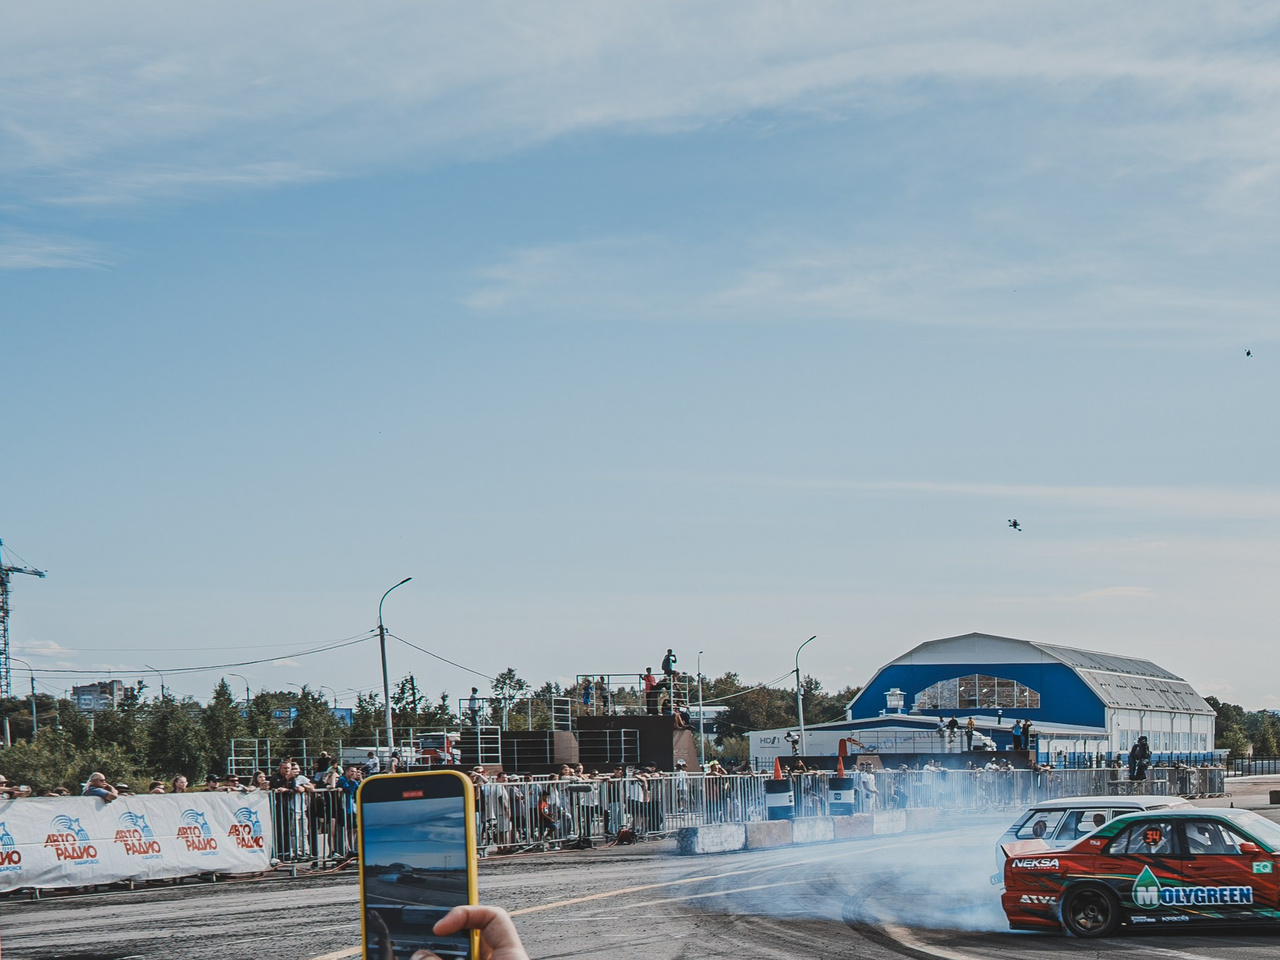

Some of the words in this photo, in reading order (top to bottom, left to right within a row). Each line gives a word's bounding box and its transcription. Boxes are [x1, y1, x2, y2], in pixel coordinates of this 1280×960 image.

[114, 829, 142, 843] АВТО
[176, 826, 201, 839] АВТО
[228, 824, 251, 837] АВТО
[1145, 831, 1160, 843] 34
[44, 833, 76, 848] АВТО
[185, 838, 217, 851] РАДИО
[236, 836, 264, 848] РАДИО
[55, 845, 97, 860] РАДИО
[124, 840, 161, 855] РАДИО
[1012, 858, 1059, 868] NEKSA
[1253, 862, 1272, 873] FQ
[1136, 886, 1253, 906] MOLYGREEN
